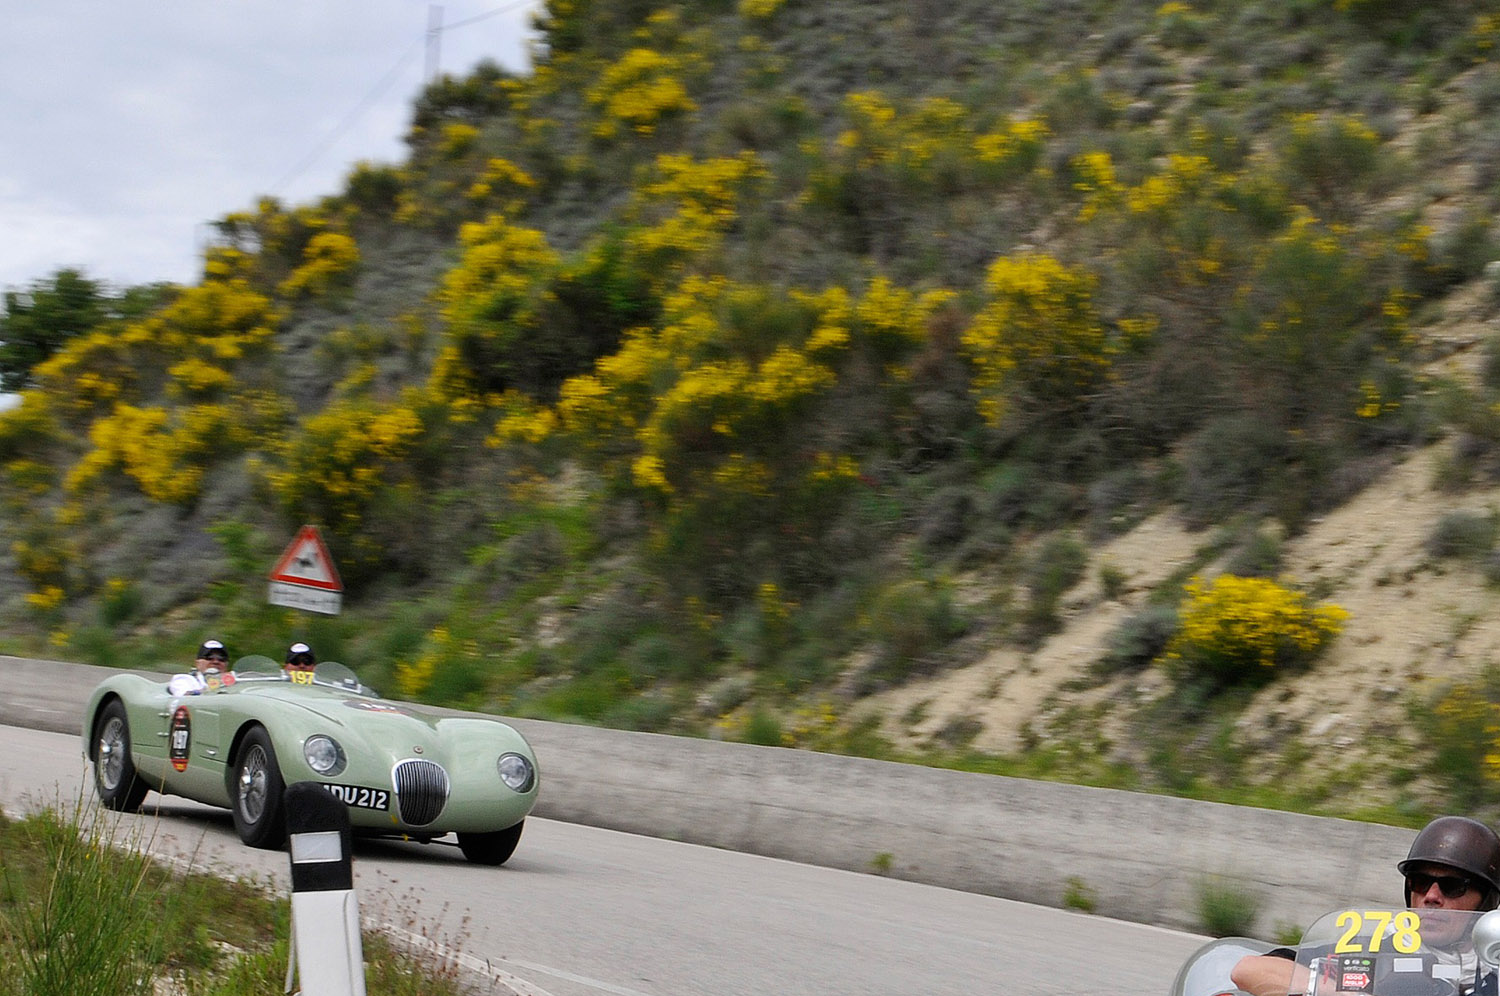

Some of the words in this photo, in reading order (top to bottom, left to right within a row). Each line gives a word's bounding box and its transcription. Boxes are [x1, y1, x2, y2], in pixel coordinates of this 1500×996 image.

[289, 671, 315, 685] 197
[323, 784, 387, 809] DU212
[1335, 910, 1422, 954] 278
